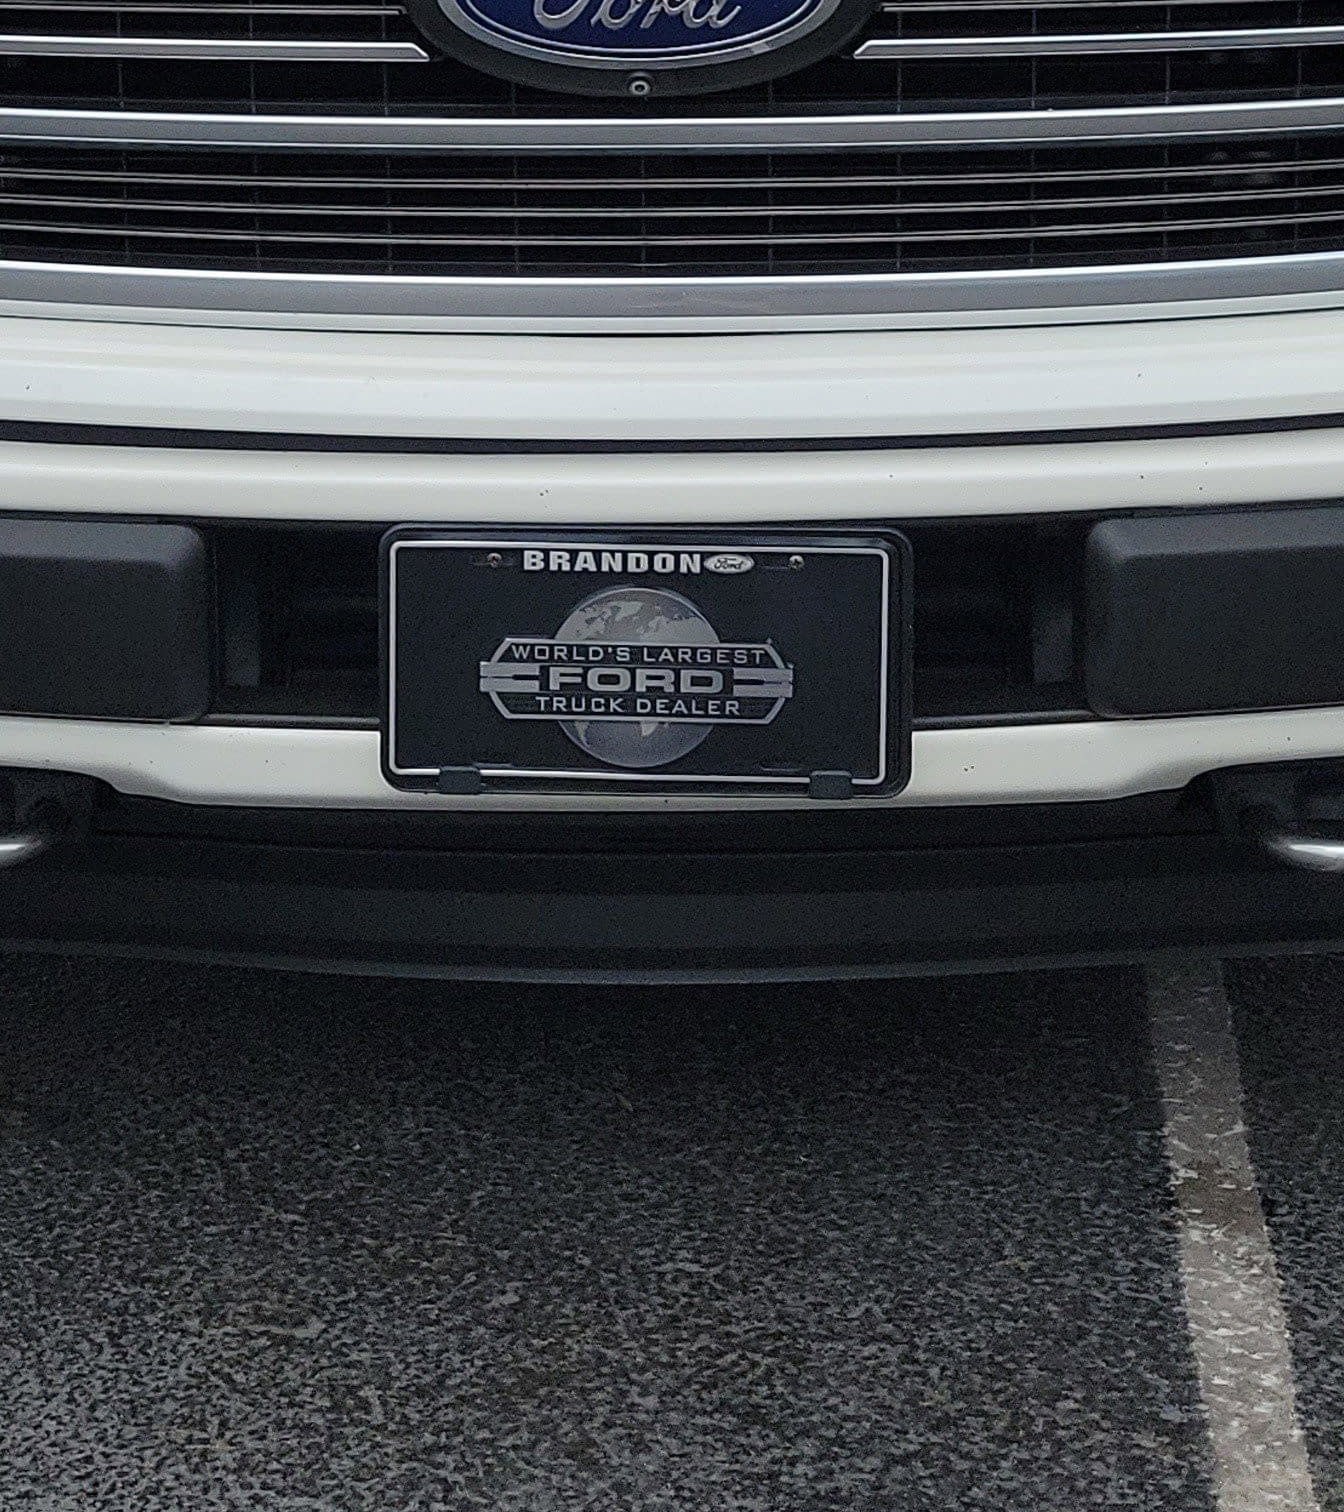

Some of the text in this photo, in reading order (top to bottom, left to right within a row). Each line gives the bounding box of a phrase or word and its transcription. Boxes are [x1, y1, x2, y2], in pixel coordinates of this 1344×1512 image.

[523, 550, 701, 574] BRANDON
[511, 644, 766, 665] WORLD'S LARGEST
[548, 666, 725, 694] FORD
[535, 696, 741, 716] TRUCK DEALER
